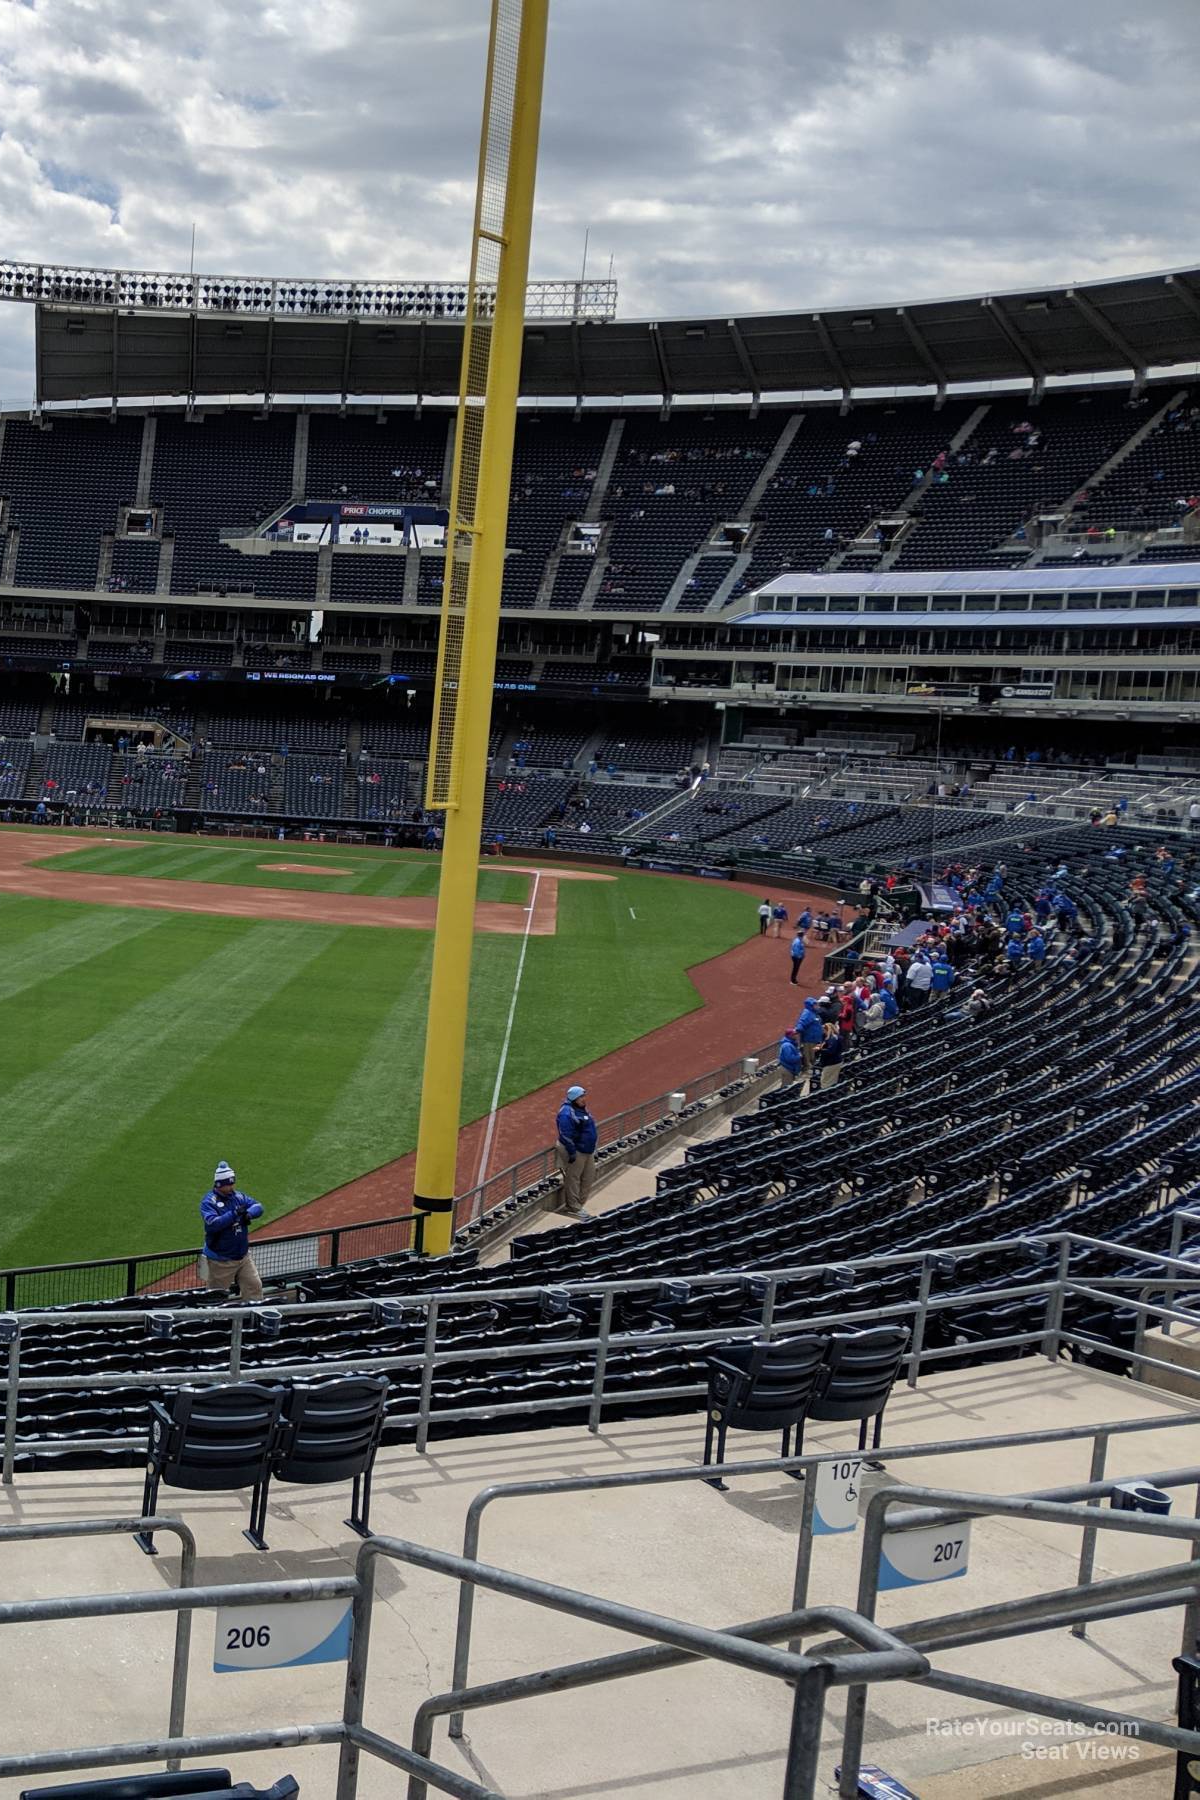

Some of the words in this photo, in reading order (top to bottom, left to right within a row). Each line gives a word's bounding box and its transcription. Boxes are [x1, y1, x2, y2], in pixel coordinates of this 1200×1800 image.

[343, 507, 365, 515] PRICE
[368, 507, 401, 516] CHOPPER
[832, 1462, 861, 1481] 107
[933, 1540, 963, 1563] 207
[226, 1625, 271, 1650] 206
